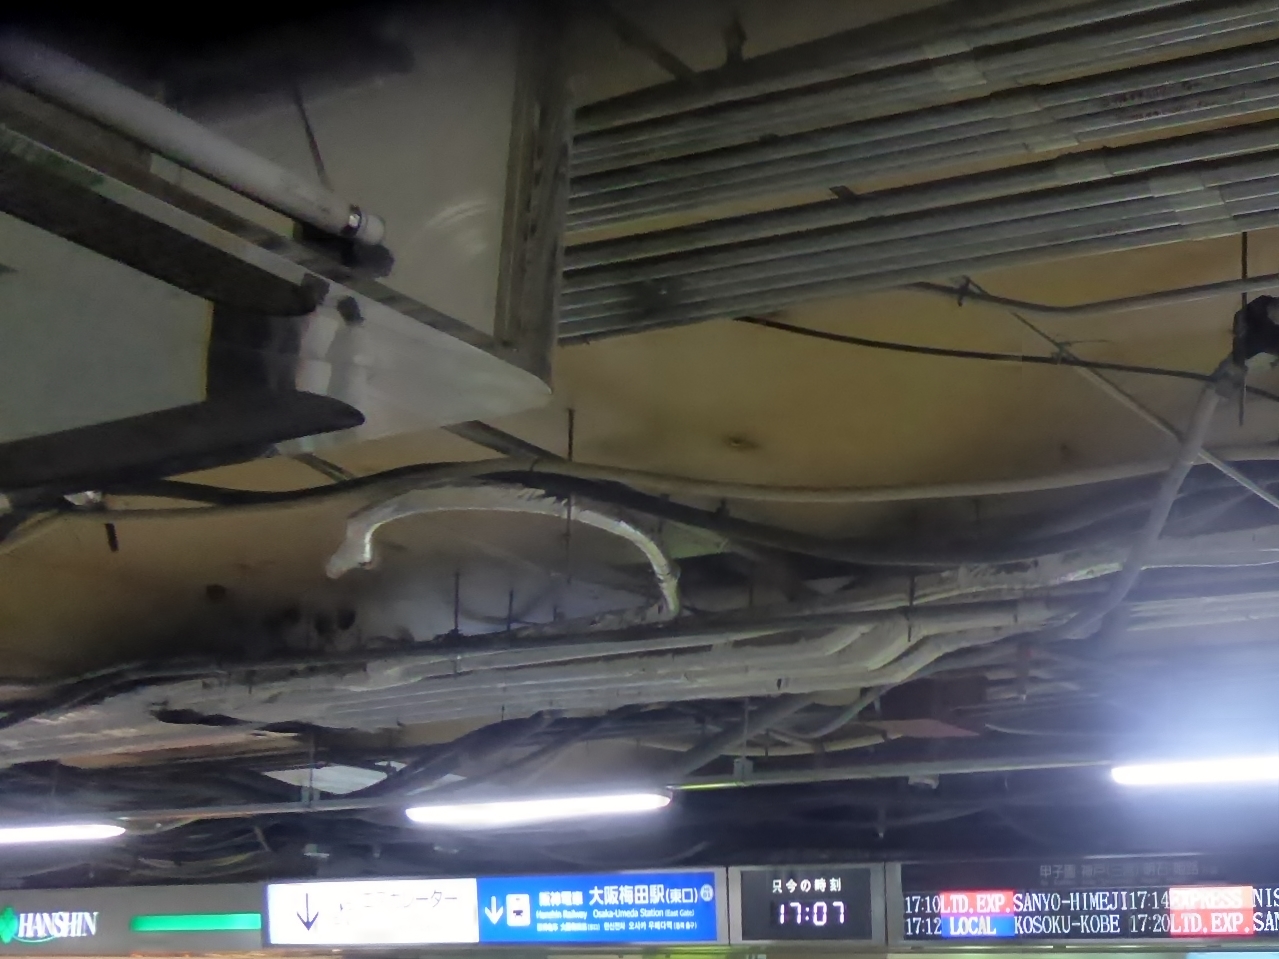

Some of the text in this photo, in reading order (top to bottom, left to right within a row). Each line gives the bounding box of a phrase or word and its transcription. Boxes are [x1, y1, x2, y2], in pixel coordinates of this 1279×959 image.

[771, 877, 843, 894] 只今の時刻
[592, 907, 639, 919] Osaka-Umeda
[639, 907, 664, 918] Station
[904, 895, 941, 914] 17:10
[1013, 889, 1128, 912] SANYO-HIMEJI
[1128, 890, 1169, 910] 17:14
[1171, 889, 1243, 909] EXPRESS
[18, 911, 99, 938] HANSHIN
[778, 901, 846, 926] 17:07
[904, 916, 942, 935] 17:12
[949, 915, 997, 935] LOCAL
[1013, 914, 1121, 935] KOSOKU-KOBE
[1129, 913, 1170, 933] 17:20
